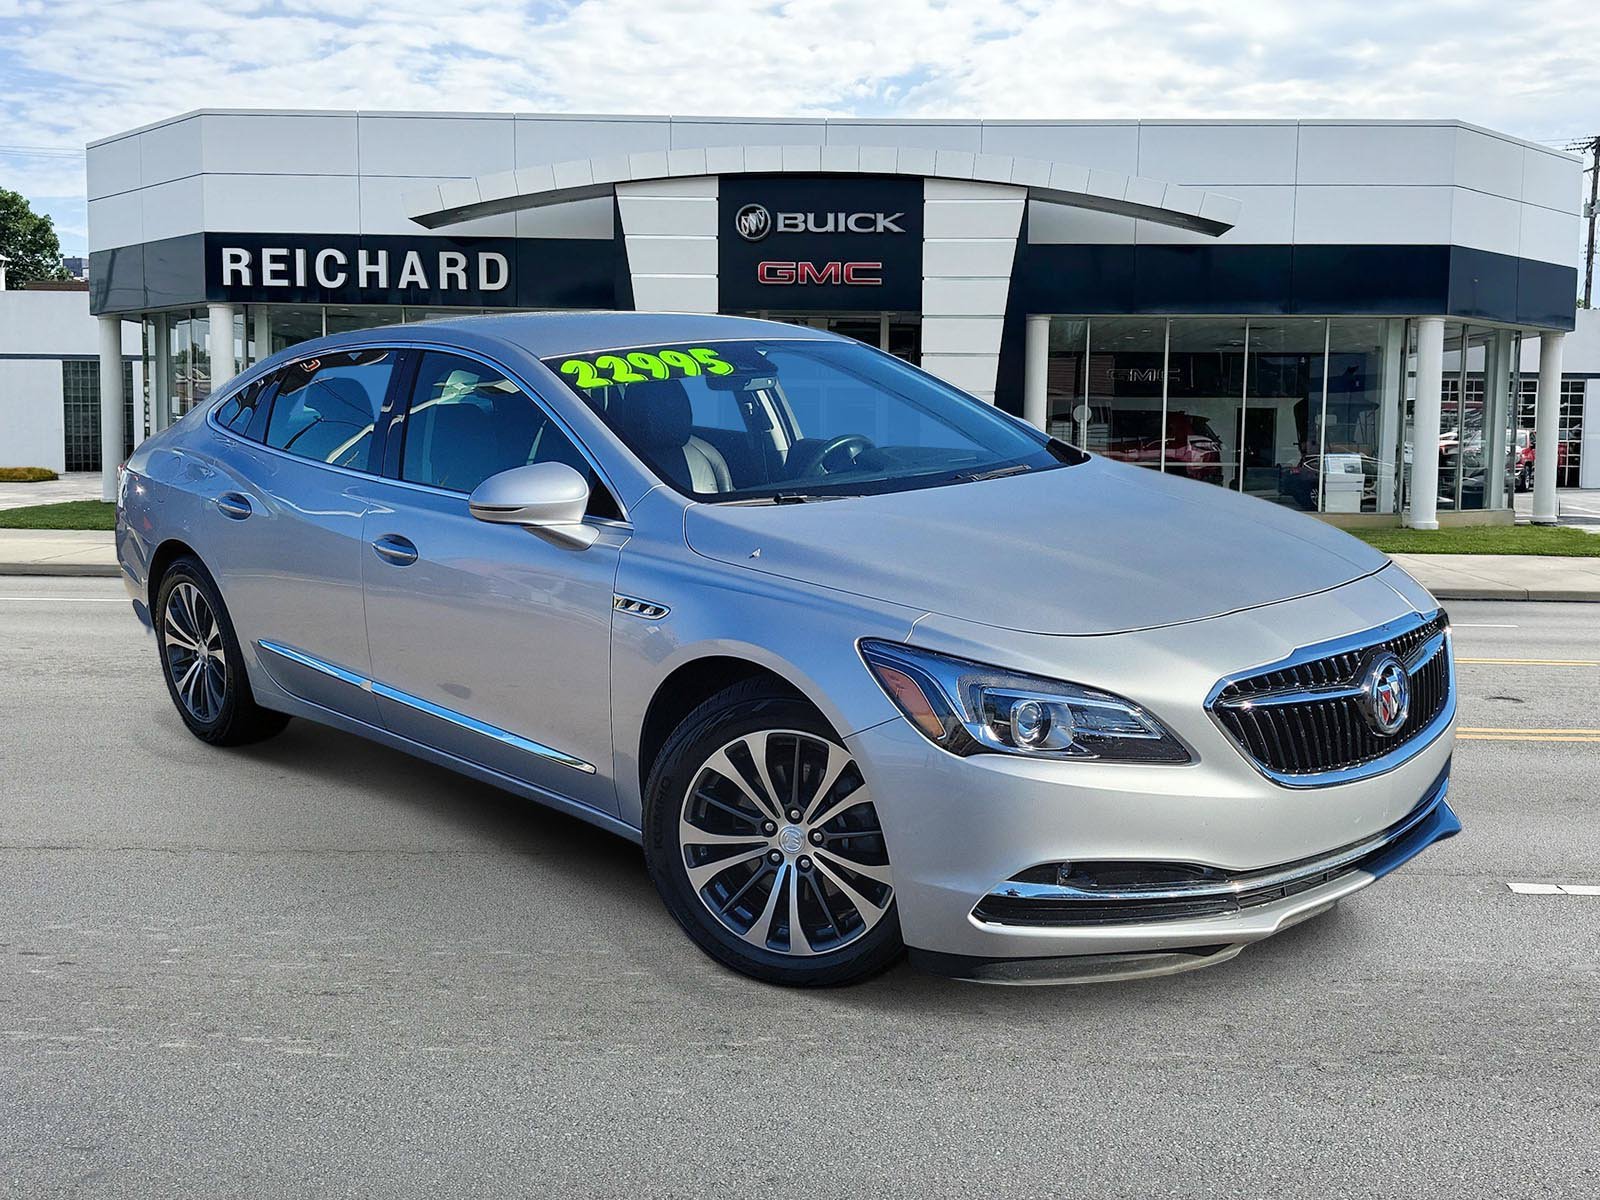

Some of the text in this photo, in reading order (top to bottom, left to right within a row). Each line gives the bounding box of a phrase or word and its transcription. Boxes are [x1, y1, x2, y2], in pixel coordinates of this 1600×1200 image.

[777, 212, 907, 233] BUICK
[221, 247, 511, 291] REICHARD
[757, 261, 883, 285] GMC
[560, 348, 735, 389] 22995
